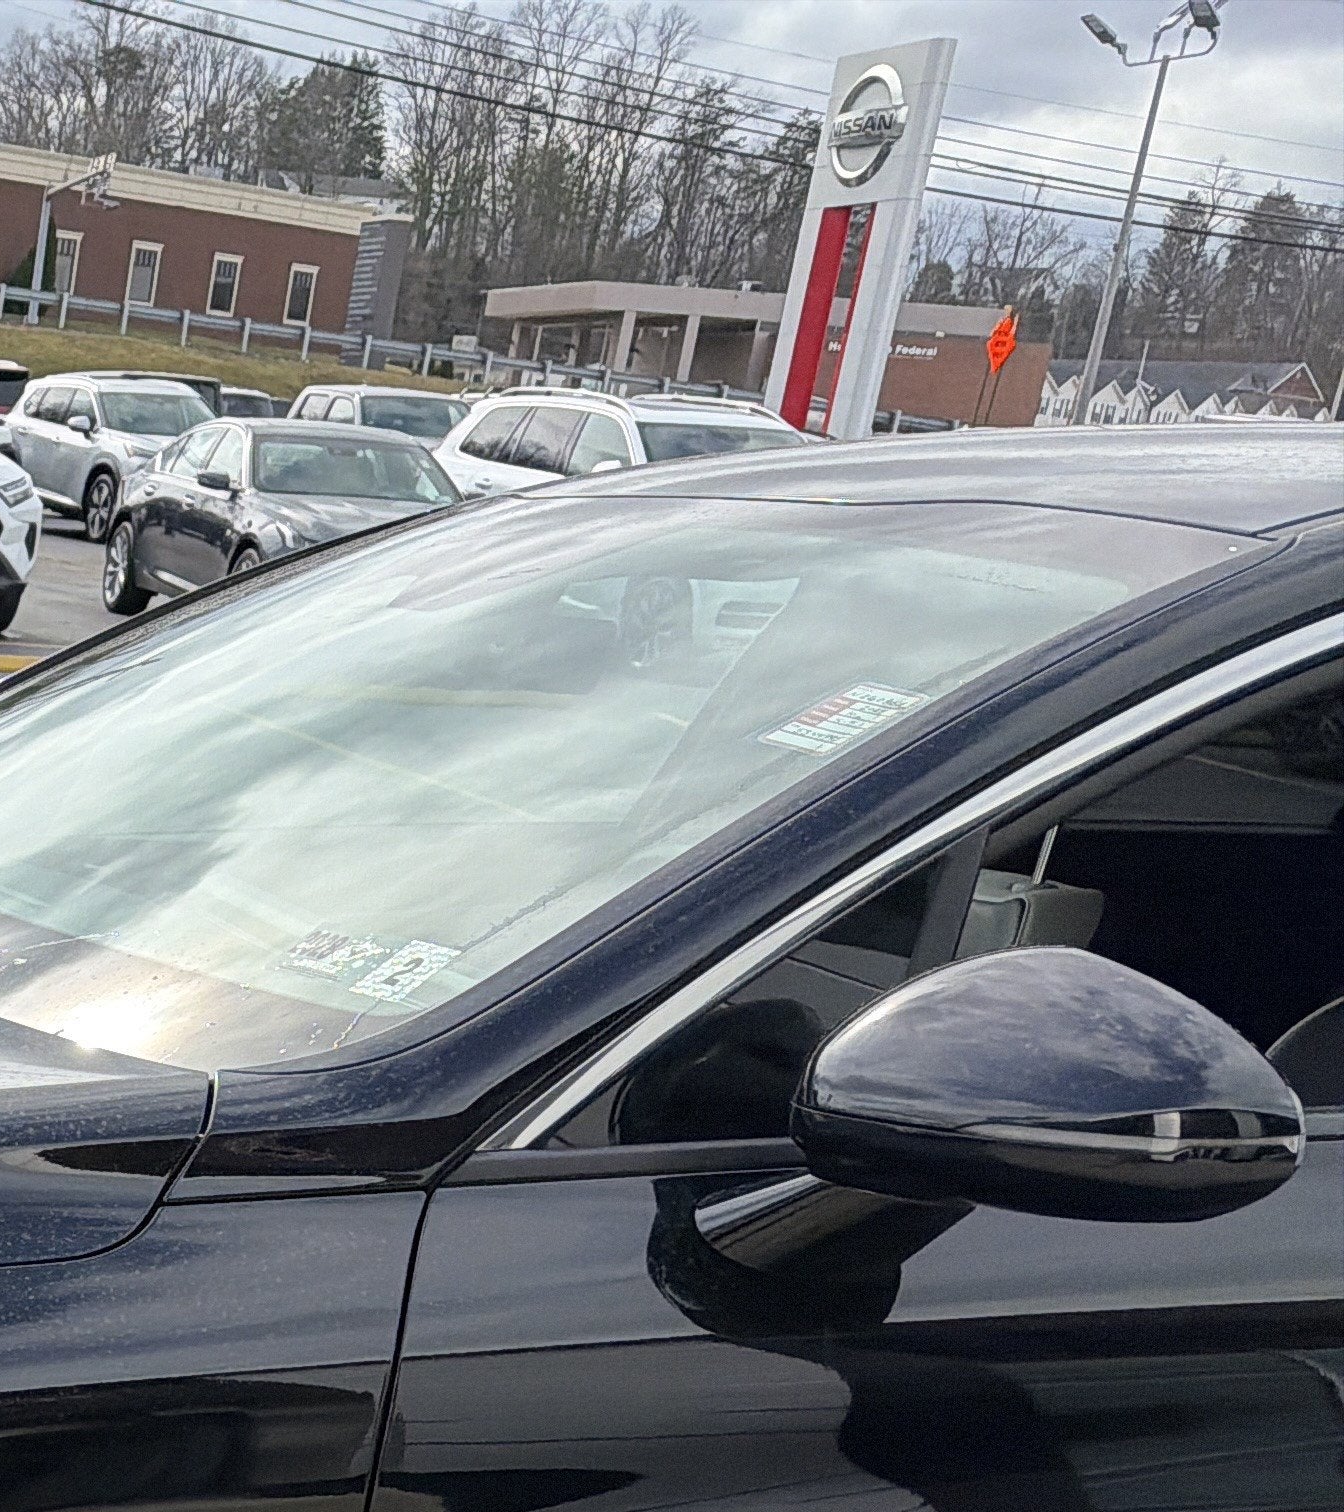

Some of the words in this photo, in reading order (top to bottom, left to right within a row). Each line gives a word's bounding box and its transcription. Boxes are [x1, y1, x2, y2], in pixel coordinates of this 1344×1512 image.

[832, 112, 895, 138] NISSAN
[895, 344, 938, 356] Federal
[382, 956, 425, 987] 2
